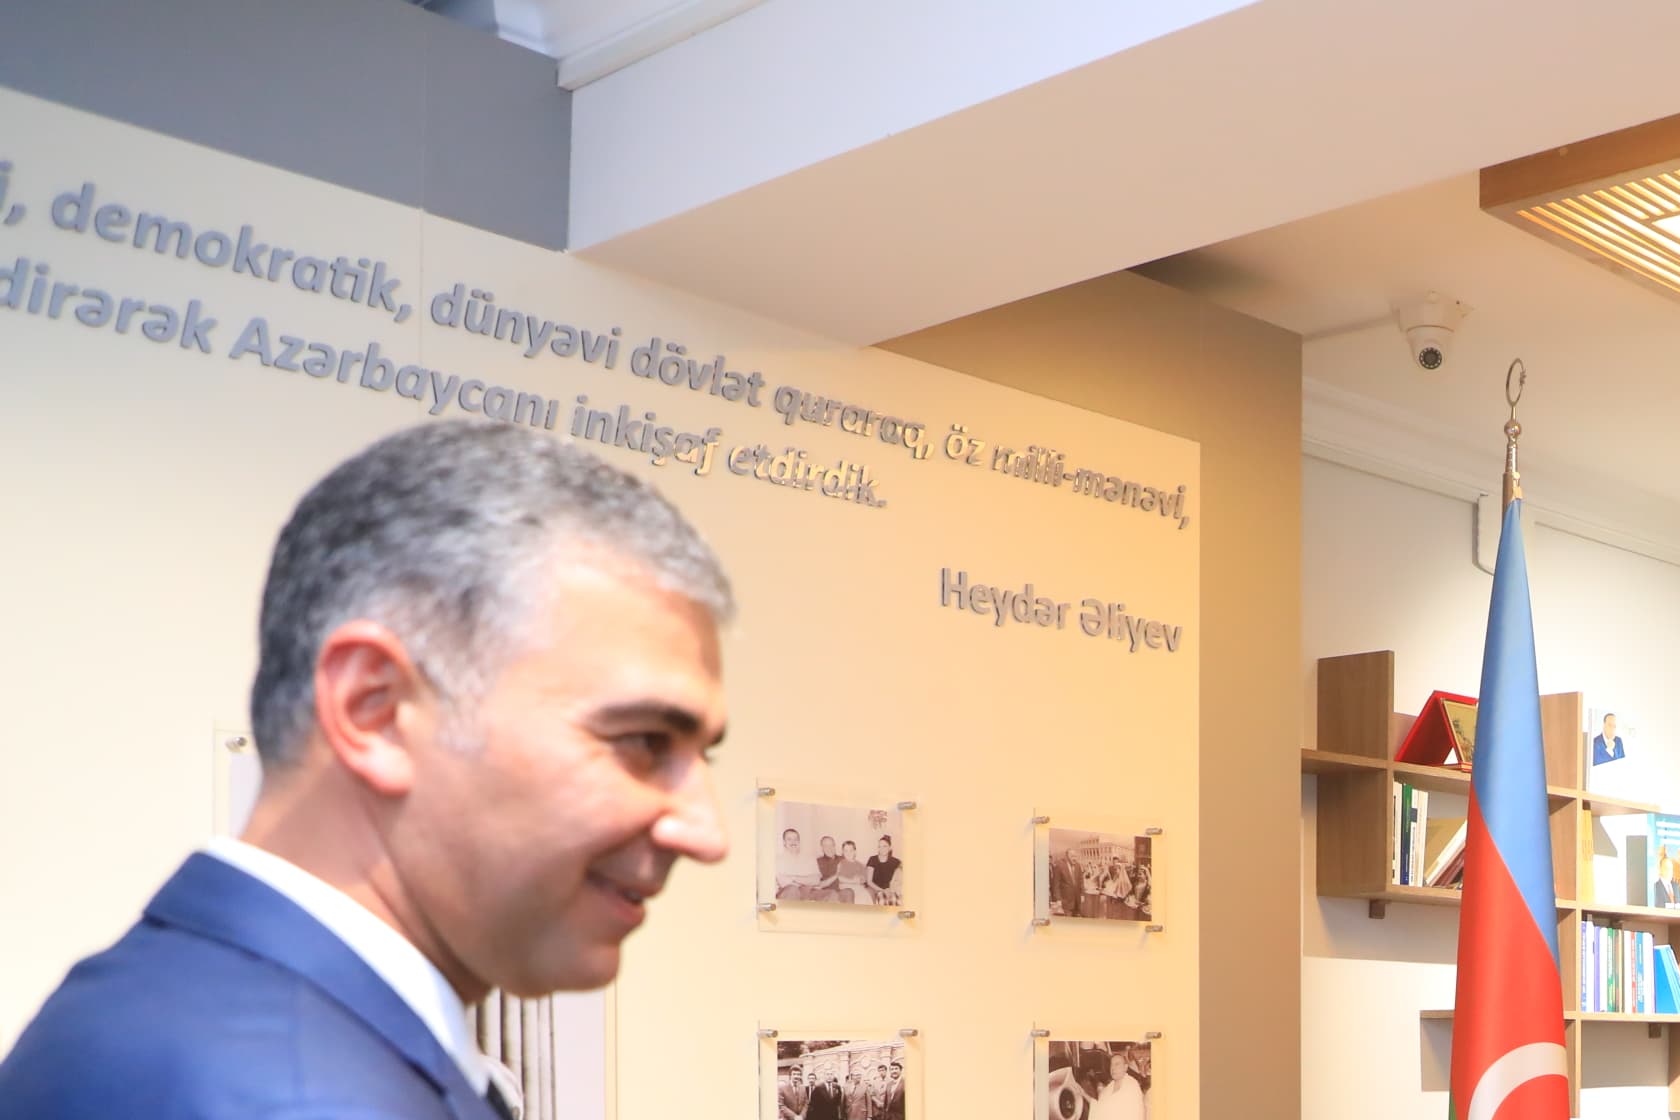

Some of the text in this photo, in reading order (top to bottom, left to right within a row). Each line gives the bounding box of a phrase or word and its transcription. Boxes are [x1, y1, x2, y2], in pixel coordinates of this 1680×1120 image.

[51, 181, 412, 323] demokratik,
[430, 283, 622, 369] dünyəvi
[630, 337, 766, 407] dövlət
[774, 385, 935, 460] quraraq,
[945, 423, 986, 467] öz
[991, 444, 1191, 530] milli-mənəvi,
[228, 317, 559, 430] Azərbaycanı
[570, 394, 722, 475] inkişaf
[940, 568, 1184, 654] Heydər Əliyev
